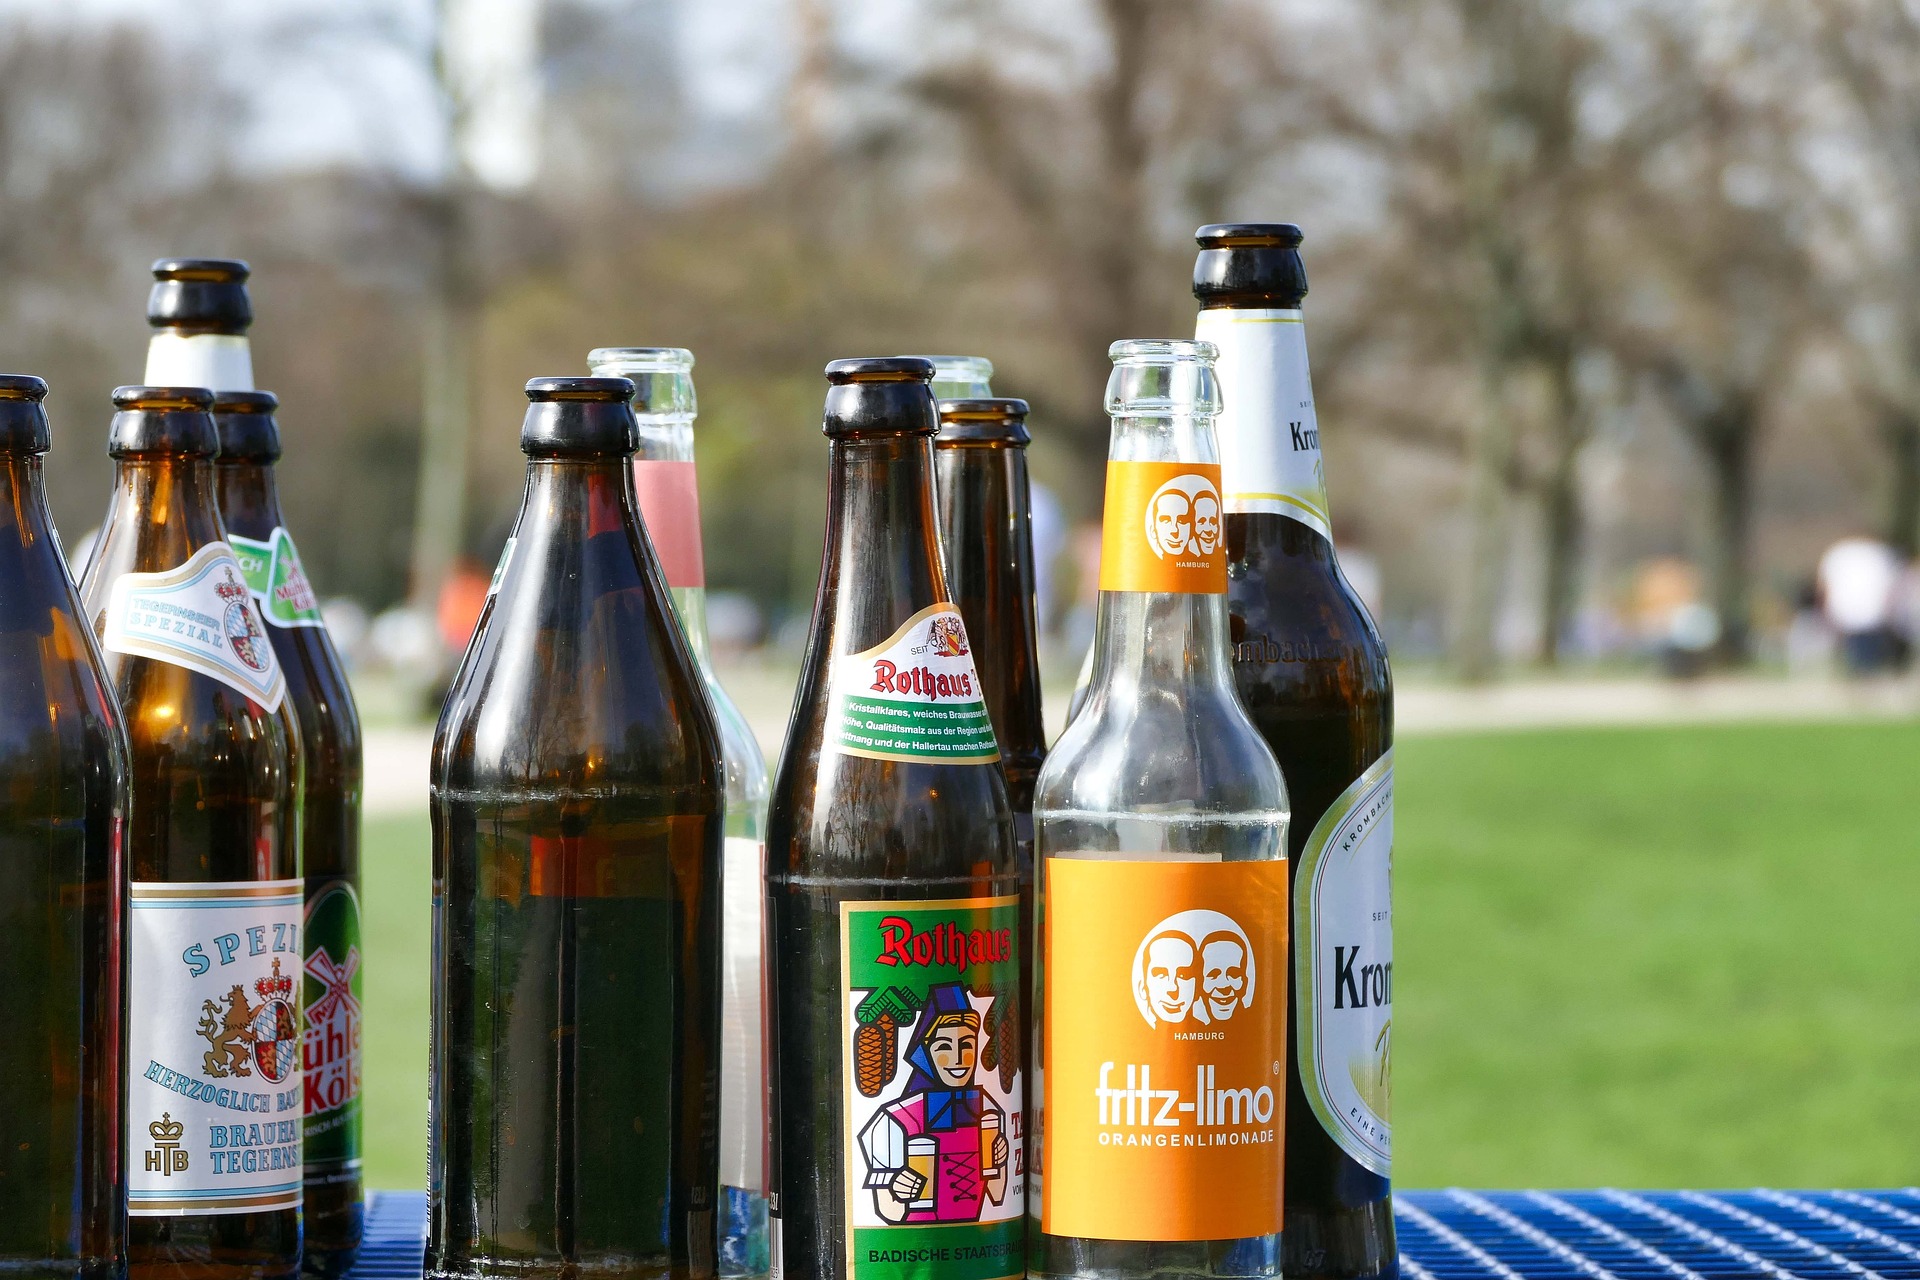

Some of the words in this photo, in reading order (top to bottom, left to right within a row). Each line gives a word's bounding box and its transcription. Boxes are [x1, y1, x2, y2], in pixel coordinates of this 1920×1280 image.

[1175, 561, 1210, 569] HAMBURG
[133, 598, 221, 632] TEGERNSEER
[130, 611, 223, 649] SPEZIAL
[911, 645, 929, 656] SEIT
[870, 659, 972, 702] Rothaus
[849, 701, 911, 718] Kristallklares,
[913, 710, 948, 719] weiches
[866, 720, 926, 735] Qualitätsmalz
[928, 727, 942, 735] aus
[943, 726, 955, 735] der
[957, 726, 978, 737] Region
[874, 739, 893, 747] und
[894, 739, 911, 749] der
[912, 741, 951, 750] Hallertau
[952, 741, 978, 751] machen
[1372, 911, 1388, 922] SEIT
[875, 915, 1012, 975] Rothaus
[1173, 1032, 1225, 1041] HAMBURG
[143, 1060, 271, 1113] HERZOGLICH
[1095, 1061, 1274, 1127] fritz-limo
[1351, 1107, 1374, 1137] EINE
[1098, 1129, 1274, 1147] ORANGENLIMONADE
[144, 1142, 189, 1177] HTB
[868, 1248, 950, 1263] BADISCHE
